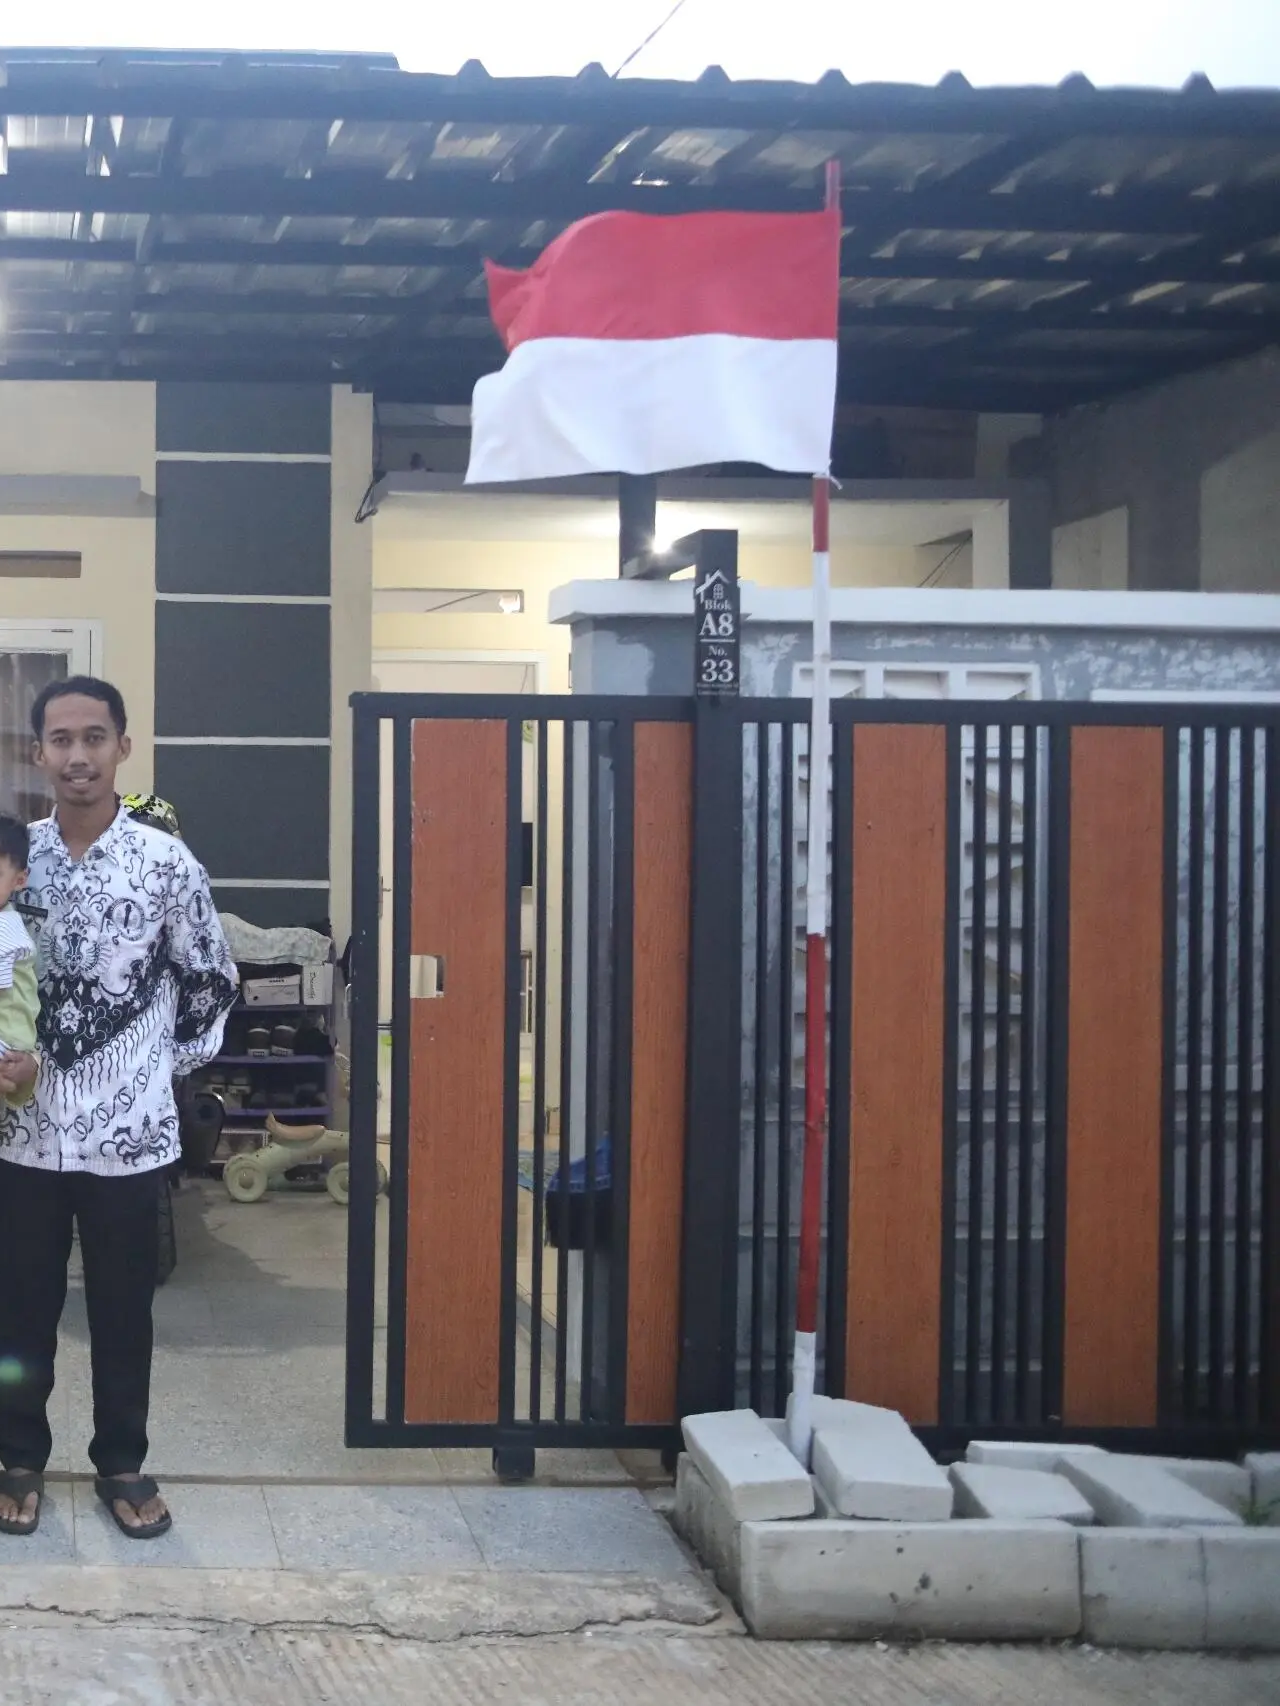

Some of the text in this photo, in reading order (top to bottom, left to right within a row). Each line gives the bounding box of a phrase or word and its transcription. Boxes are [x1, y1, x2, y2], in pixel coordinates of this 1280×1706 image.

[704, 599, 732, 610] Blok
[699, 612, 734, 636] A8
[708, 646, 728, 656] No.
[701, 659, 734, 682] 33
